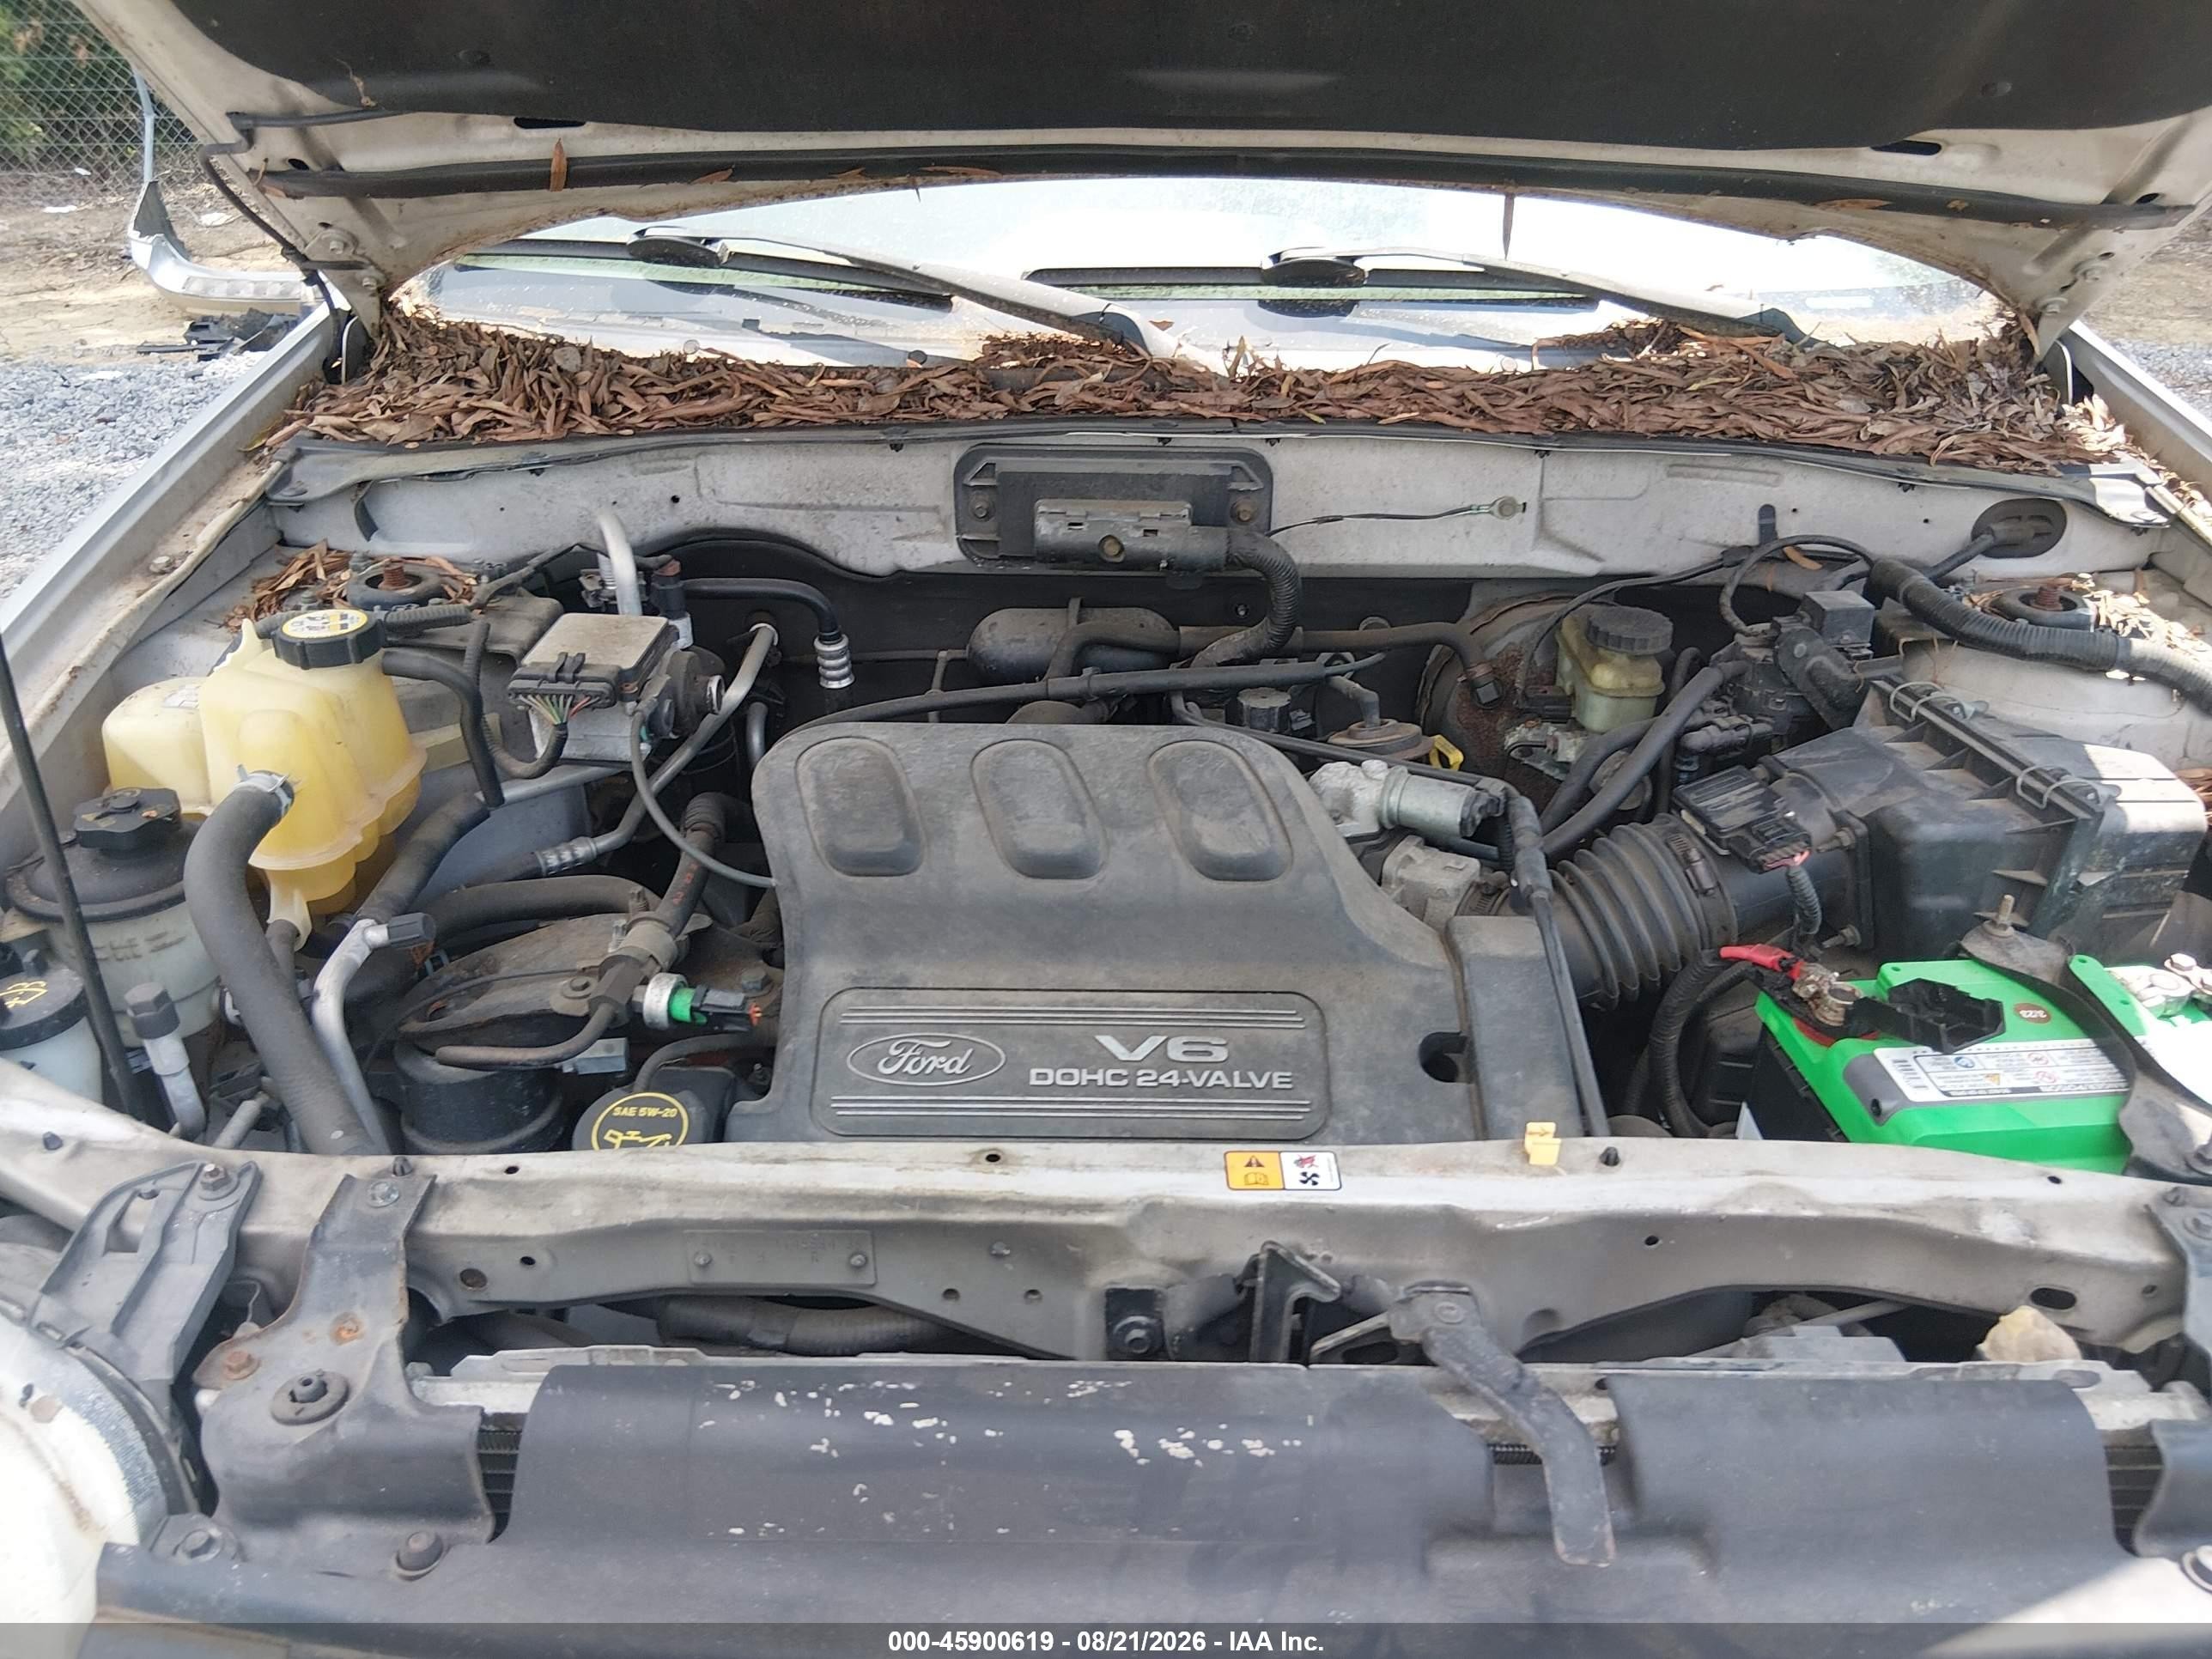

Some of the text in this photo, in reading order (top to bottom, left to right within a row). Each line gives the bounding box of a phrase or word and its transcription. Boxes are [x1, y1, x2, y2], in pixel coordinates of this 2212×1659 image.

[878, 1038, 974, 1075] Ford
[1095, 1035, 1229, 1063] V6
[1029, 1068, 1293, 1090] DOHC 24-VALVE
[613, 1107, 678, 1118] SAE 5W-20
